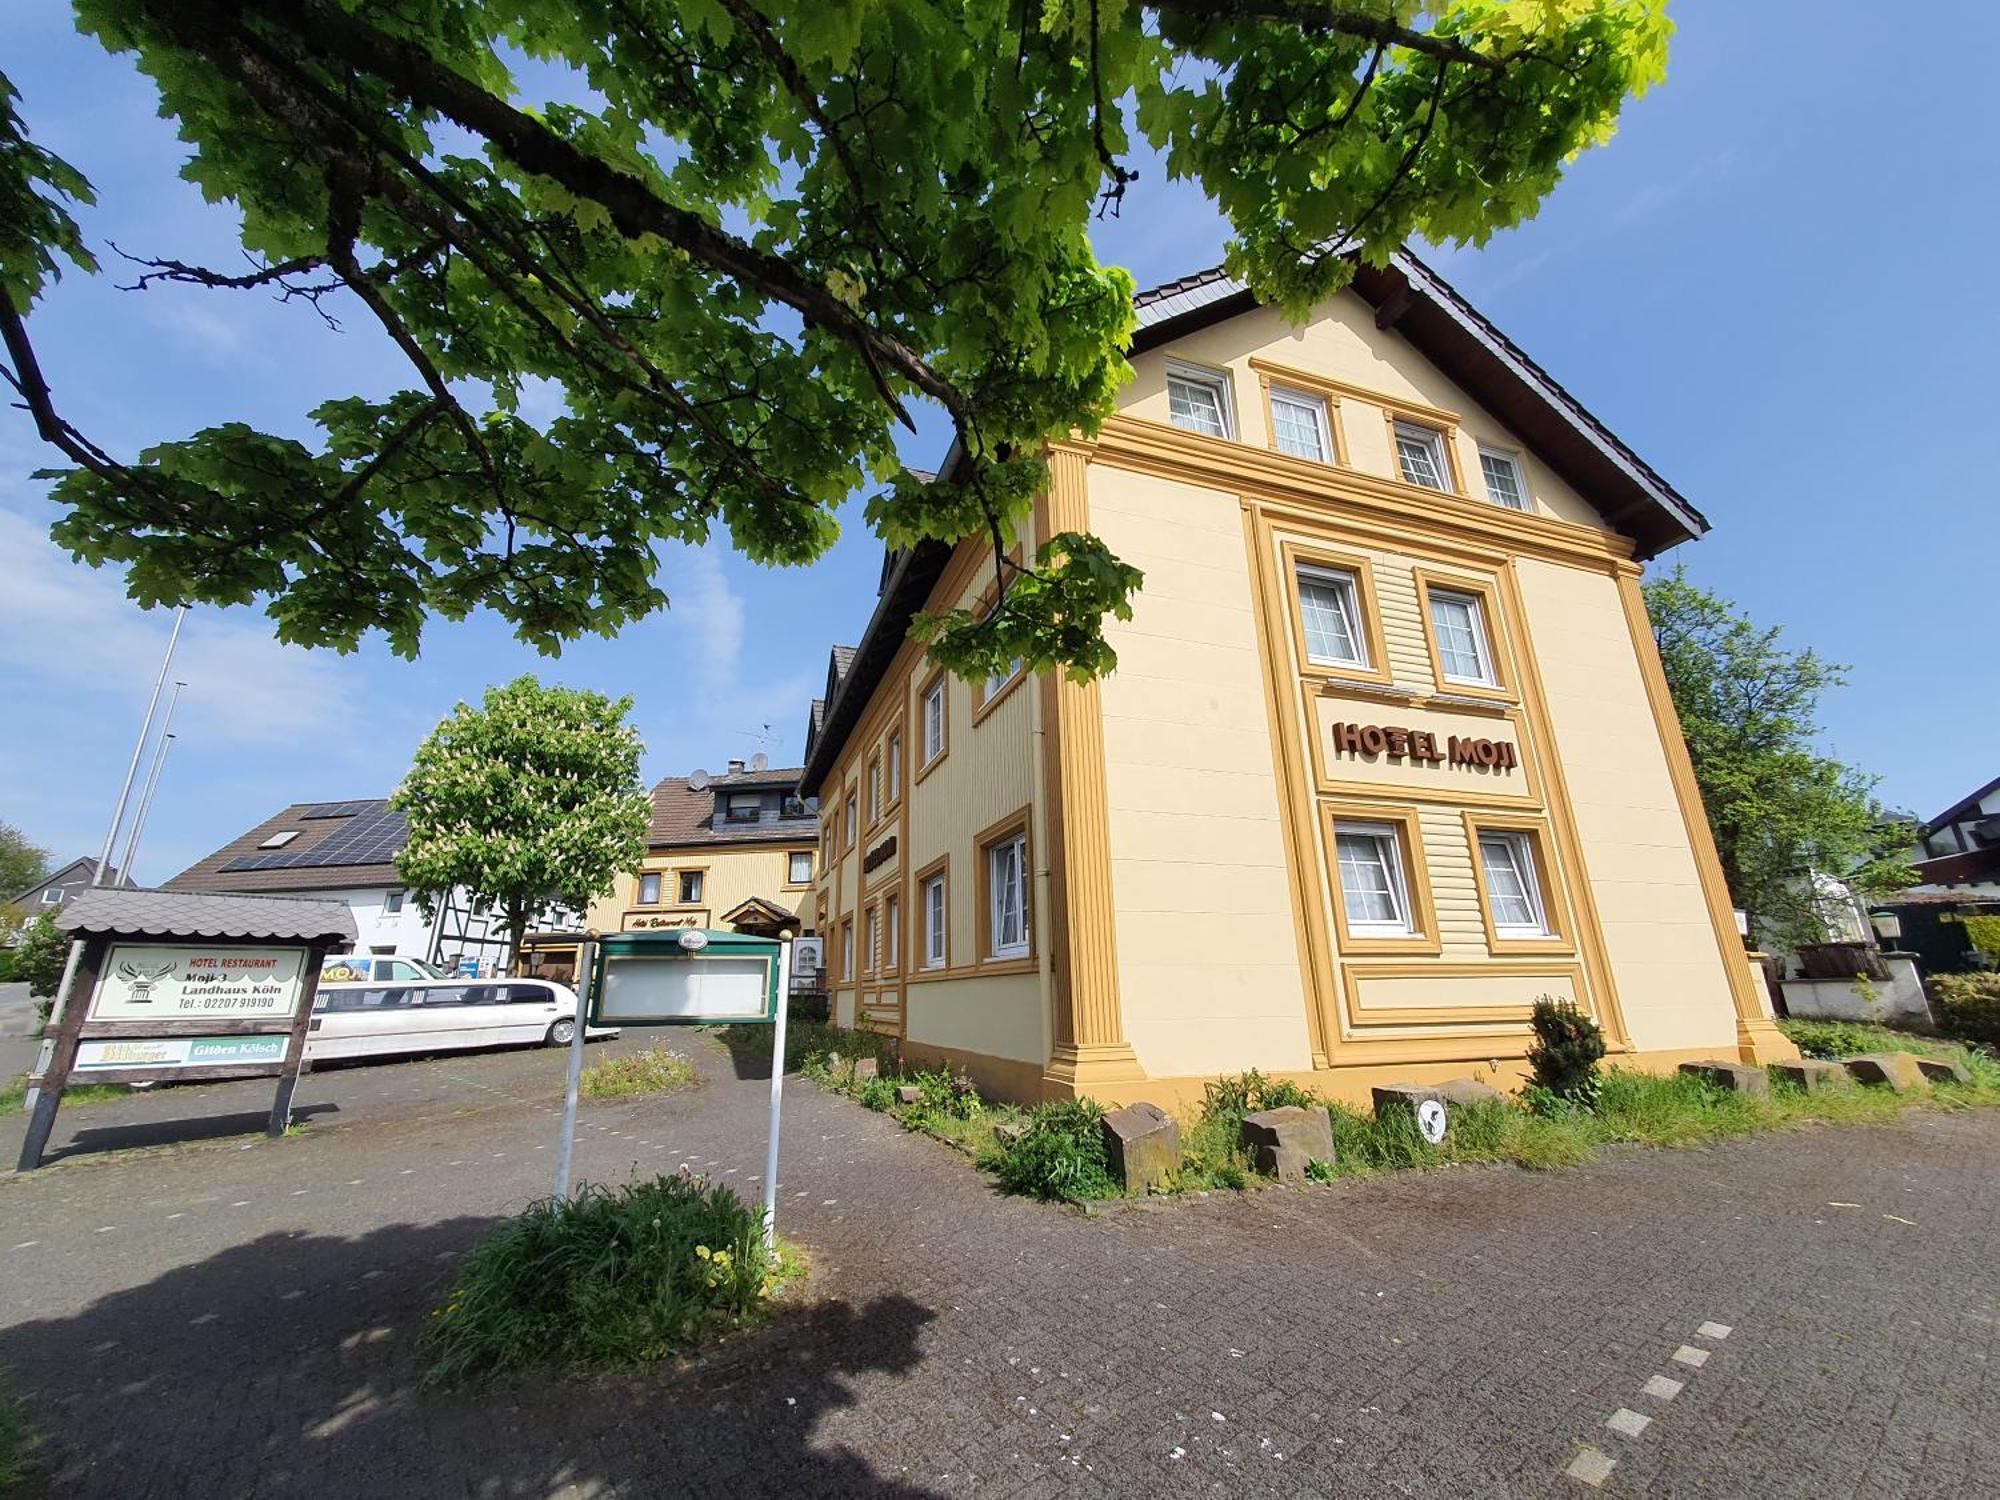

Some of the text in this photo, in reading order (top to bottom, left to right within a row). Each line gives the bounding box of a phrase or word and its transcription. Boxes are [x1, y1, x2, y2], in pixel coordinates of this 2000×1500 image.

[1332, 722, 1517, 769] HOTEL MOJI
[189, 959, 278, 969] HOTEL RESTAURANT
[182, 985, 282, 995] Landhaus Köln
[204, 998, 239, 1009] 02207
[239, 997, 275, 1008] 919190
[193, 1042, 279, 1056] Gilden Kölsch
